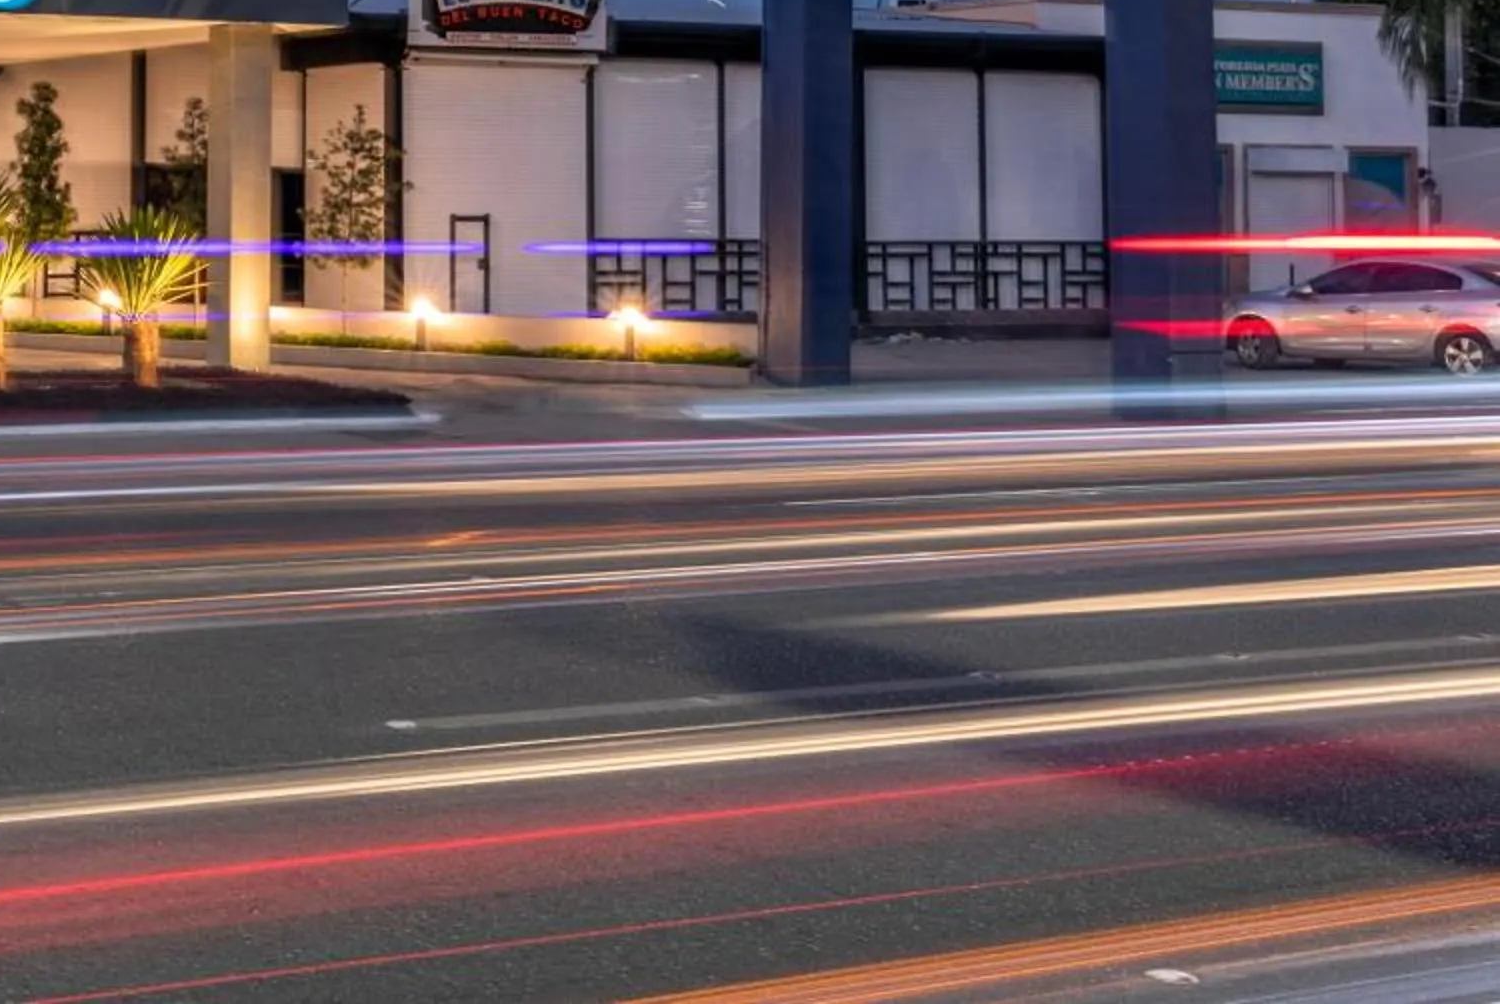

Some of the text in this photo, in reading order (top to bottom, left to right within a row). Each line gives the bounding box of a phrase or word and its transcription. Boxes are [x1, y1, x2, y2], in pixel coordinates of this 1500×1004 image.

[441, 6, 585, 29] DEL BUEN TACO
